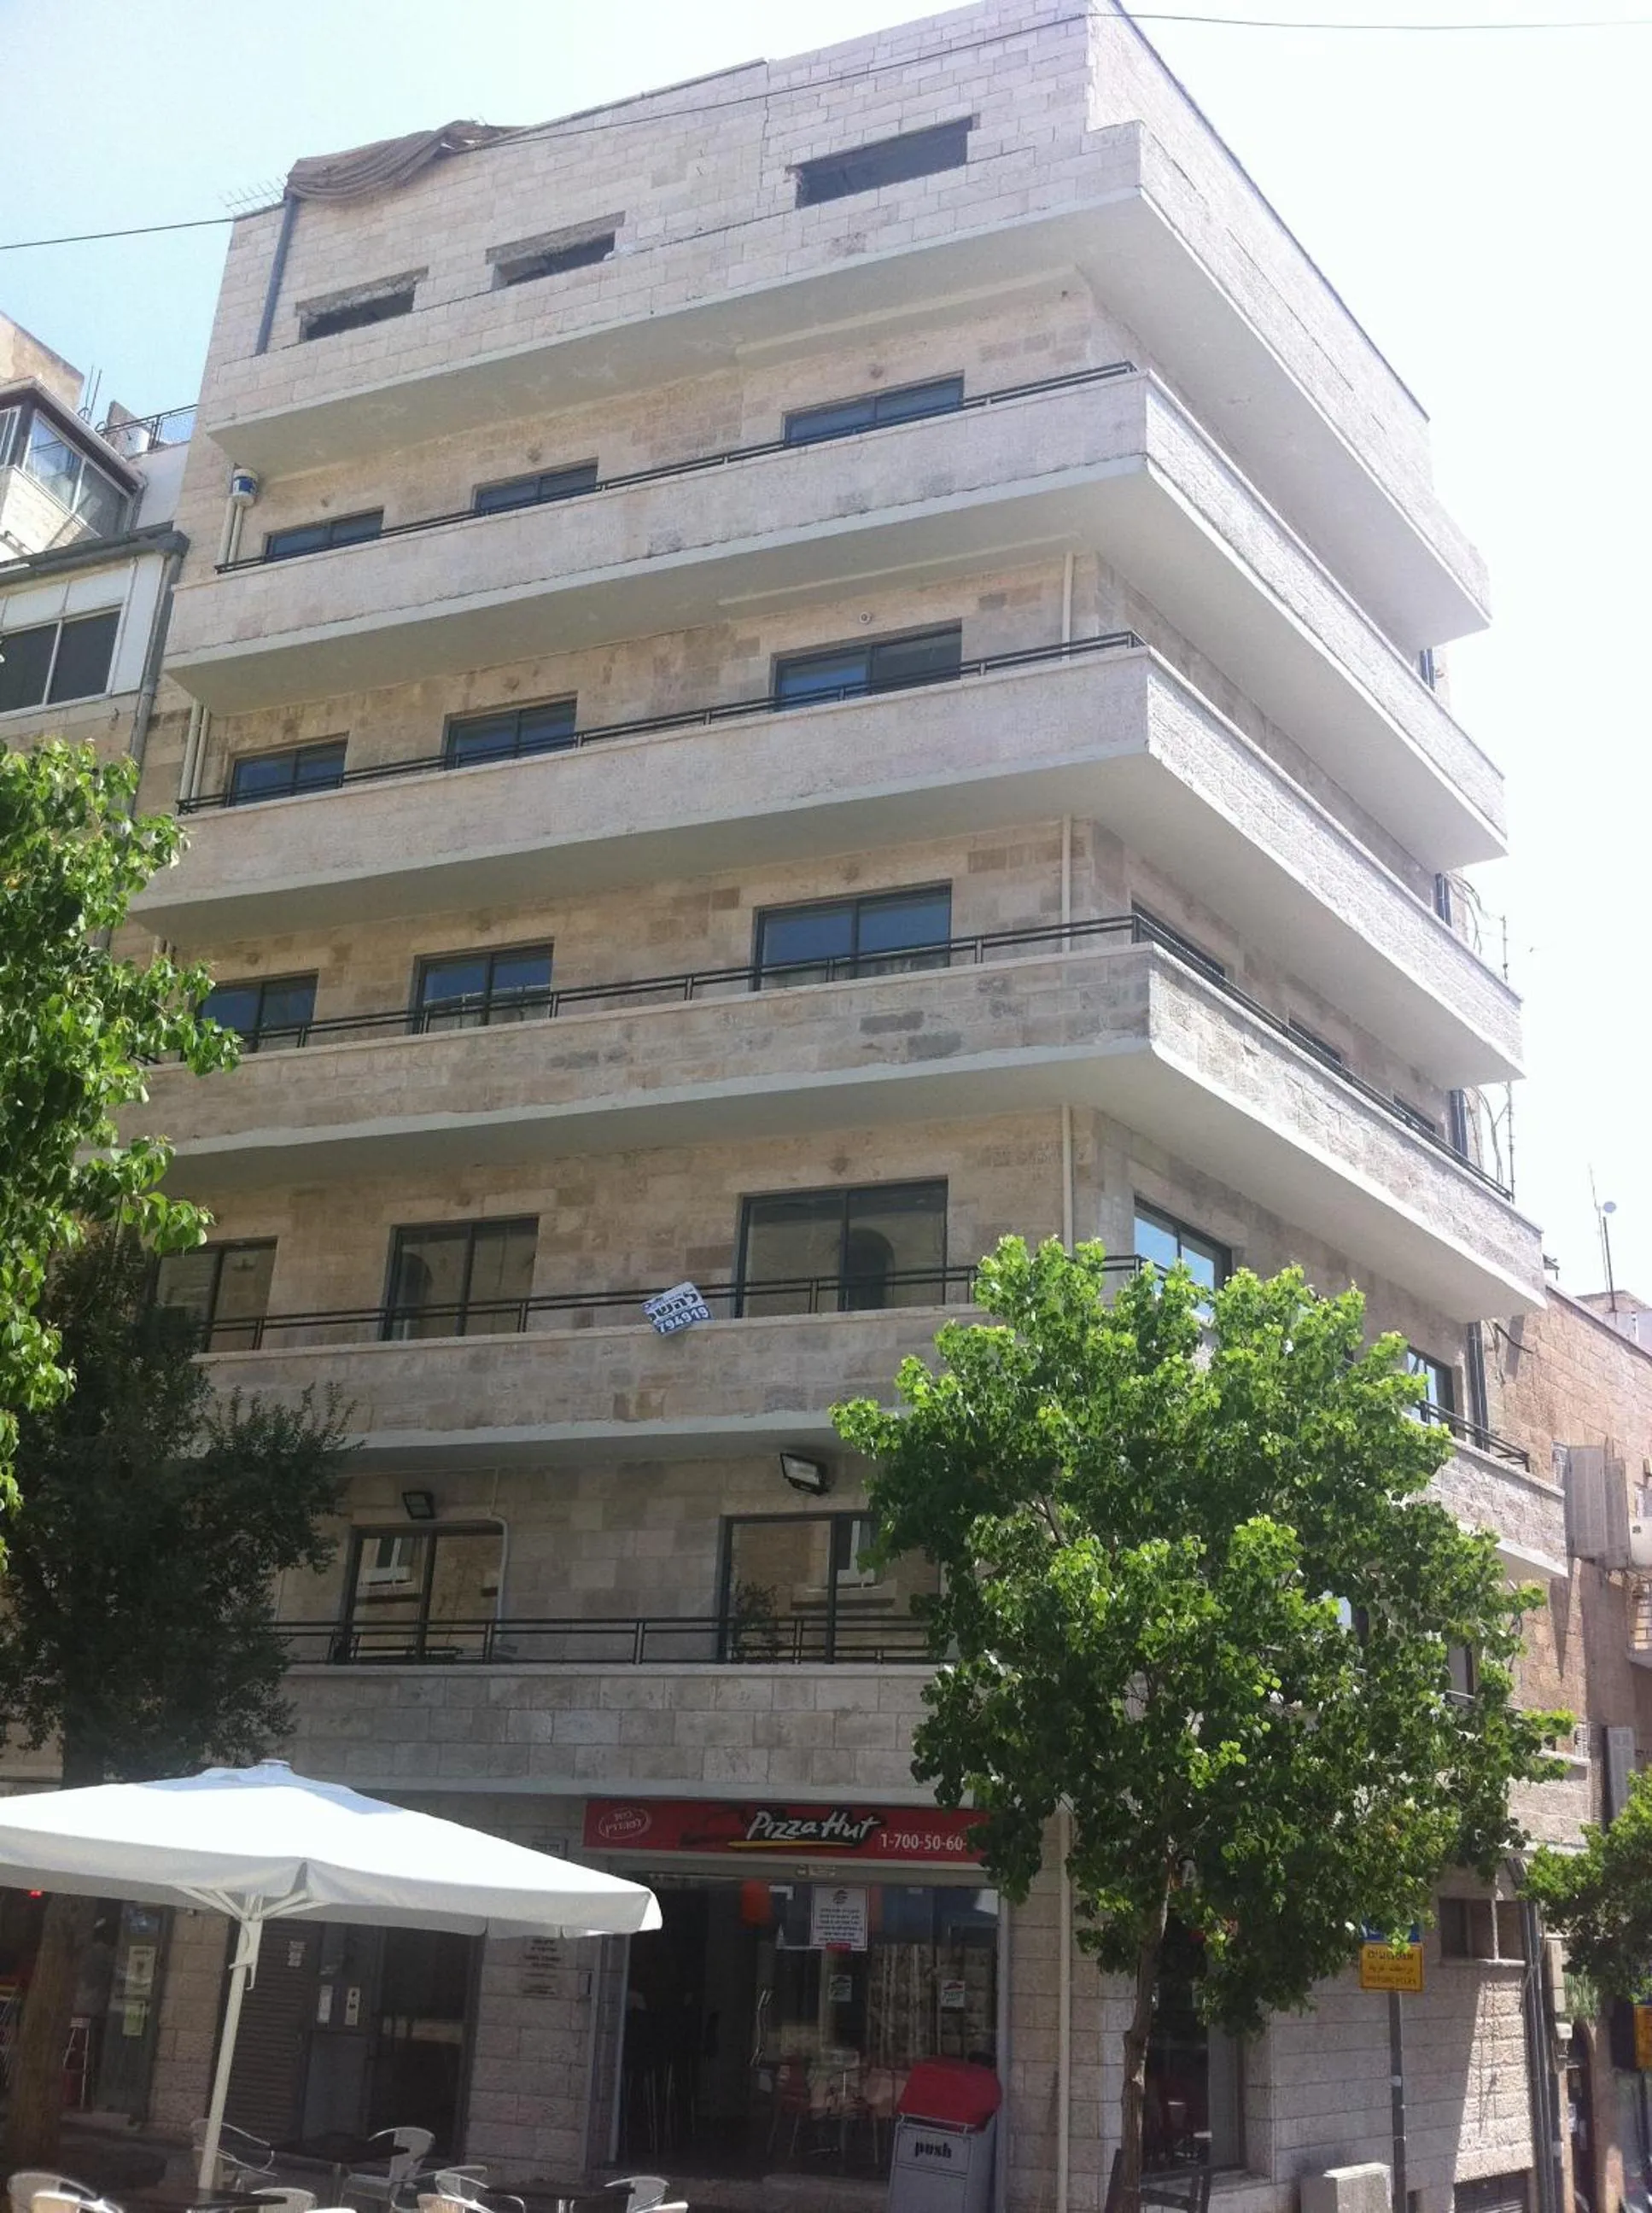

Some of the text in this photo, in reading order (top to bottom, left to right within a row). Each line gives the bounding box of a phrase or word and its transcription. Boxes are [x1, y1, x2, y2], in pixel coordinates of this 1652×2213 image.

[746, 1810, 883, 1840] Pizza Hut
[914, 2141, 953, 2159] push
